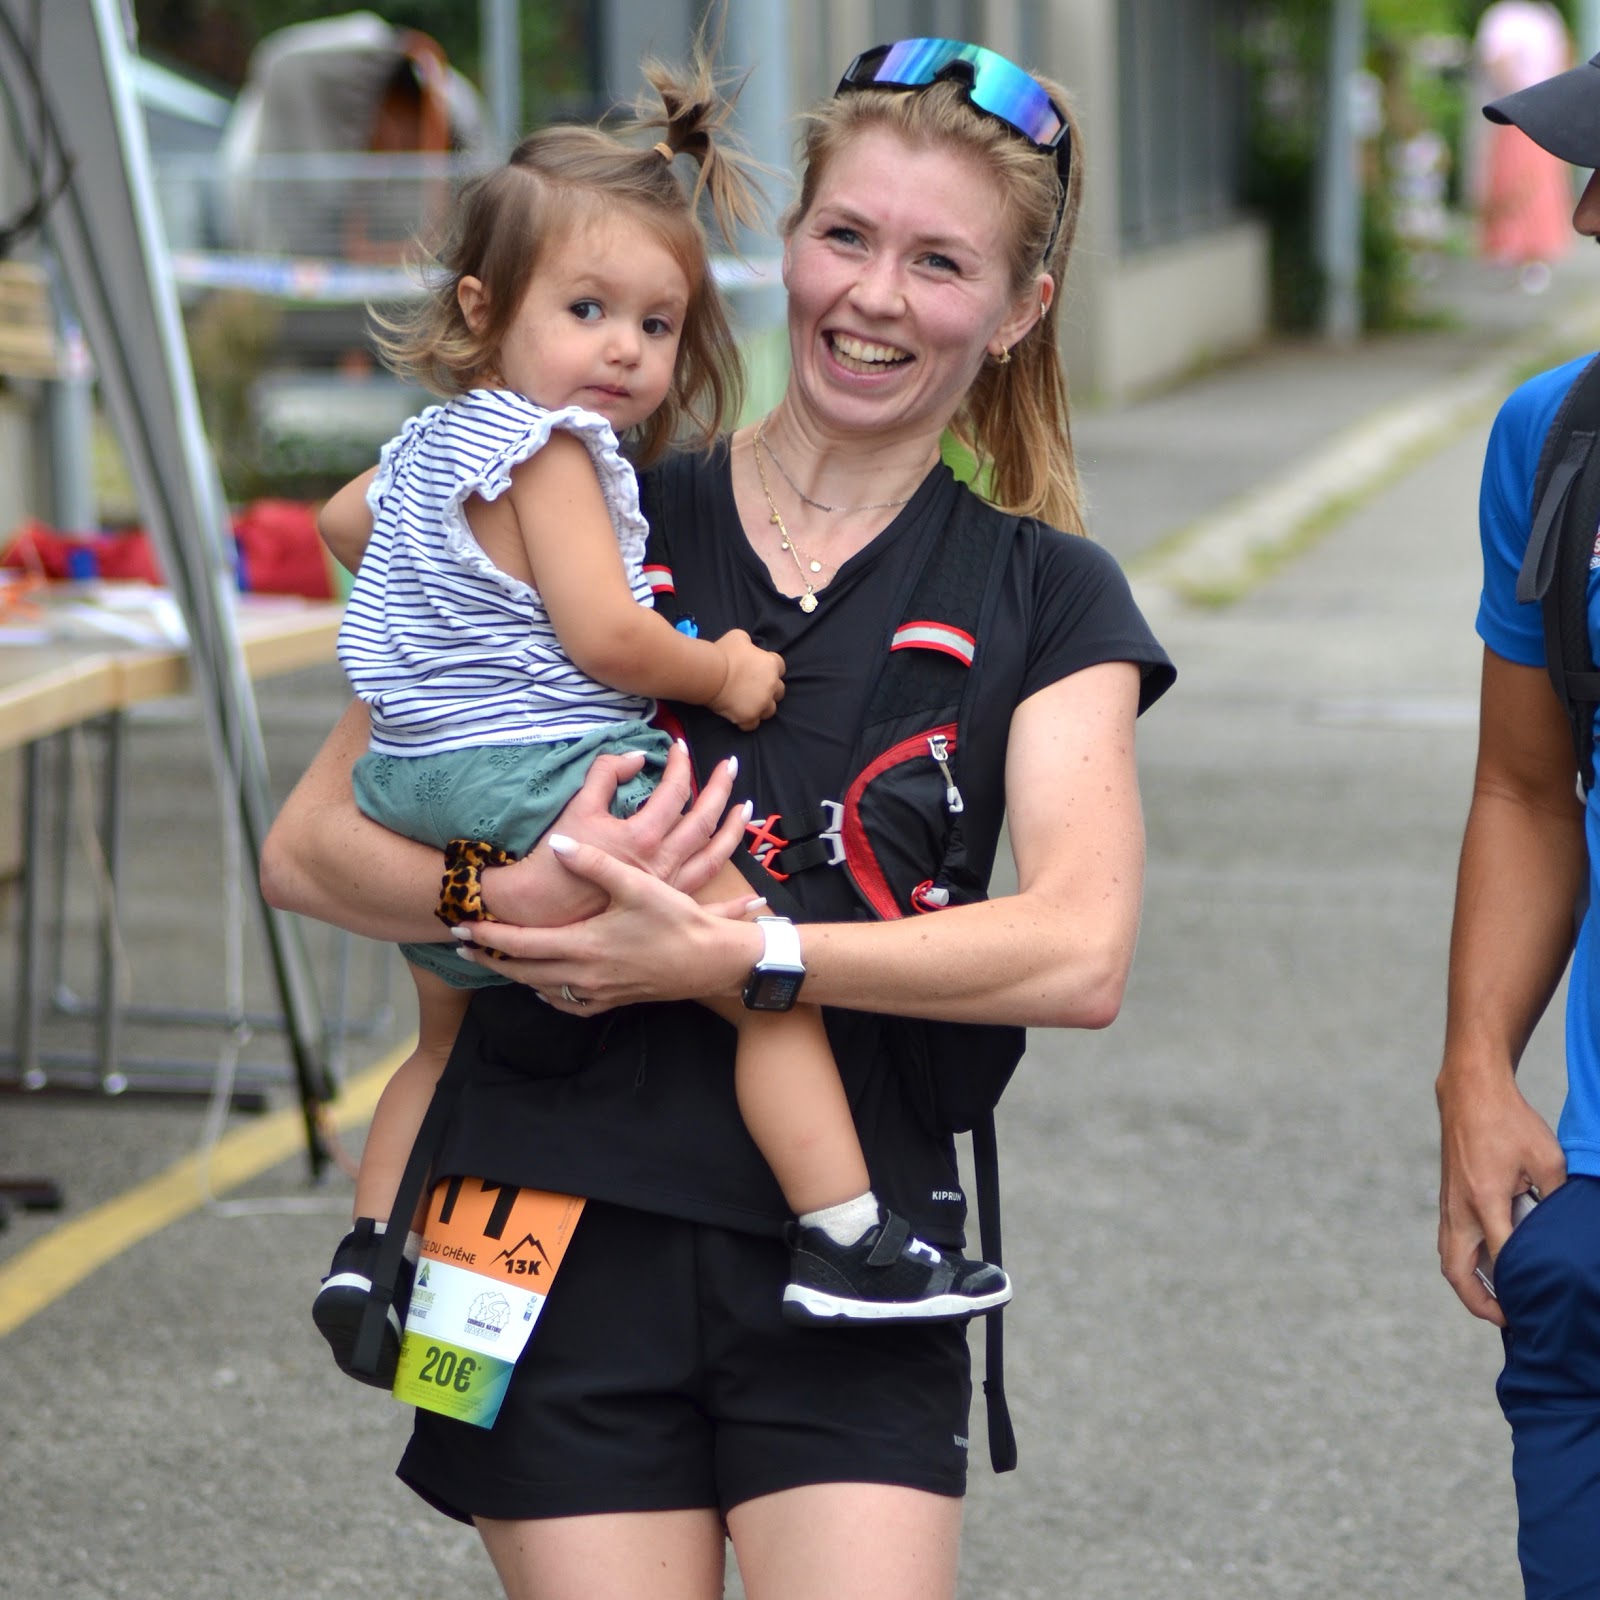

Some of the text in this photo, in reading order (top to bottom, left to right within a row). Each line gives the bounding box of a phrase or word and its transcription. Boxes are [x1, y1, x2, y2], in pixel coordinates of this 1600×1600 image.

[932, 1190, 962, 1201] KIPRUN
[429, 1241, 441, 1254] DU
[442, 1246, 477, 1265] CHÊNE
[504, 1259, 542, 1276] 13K
